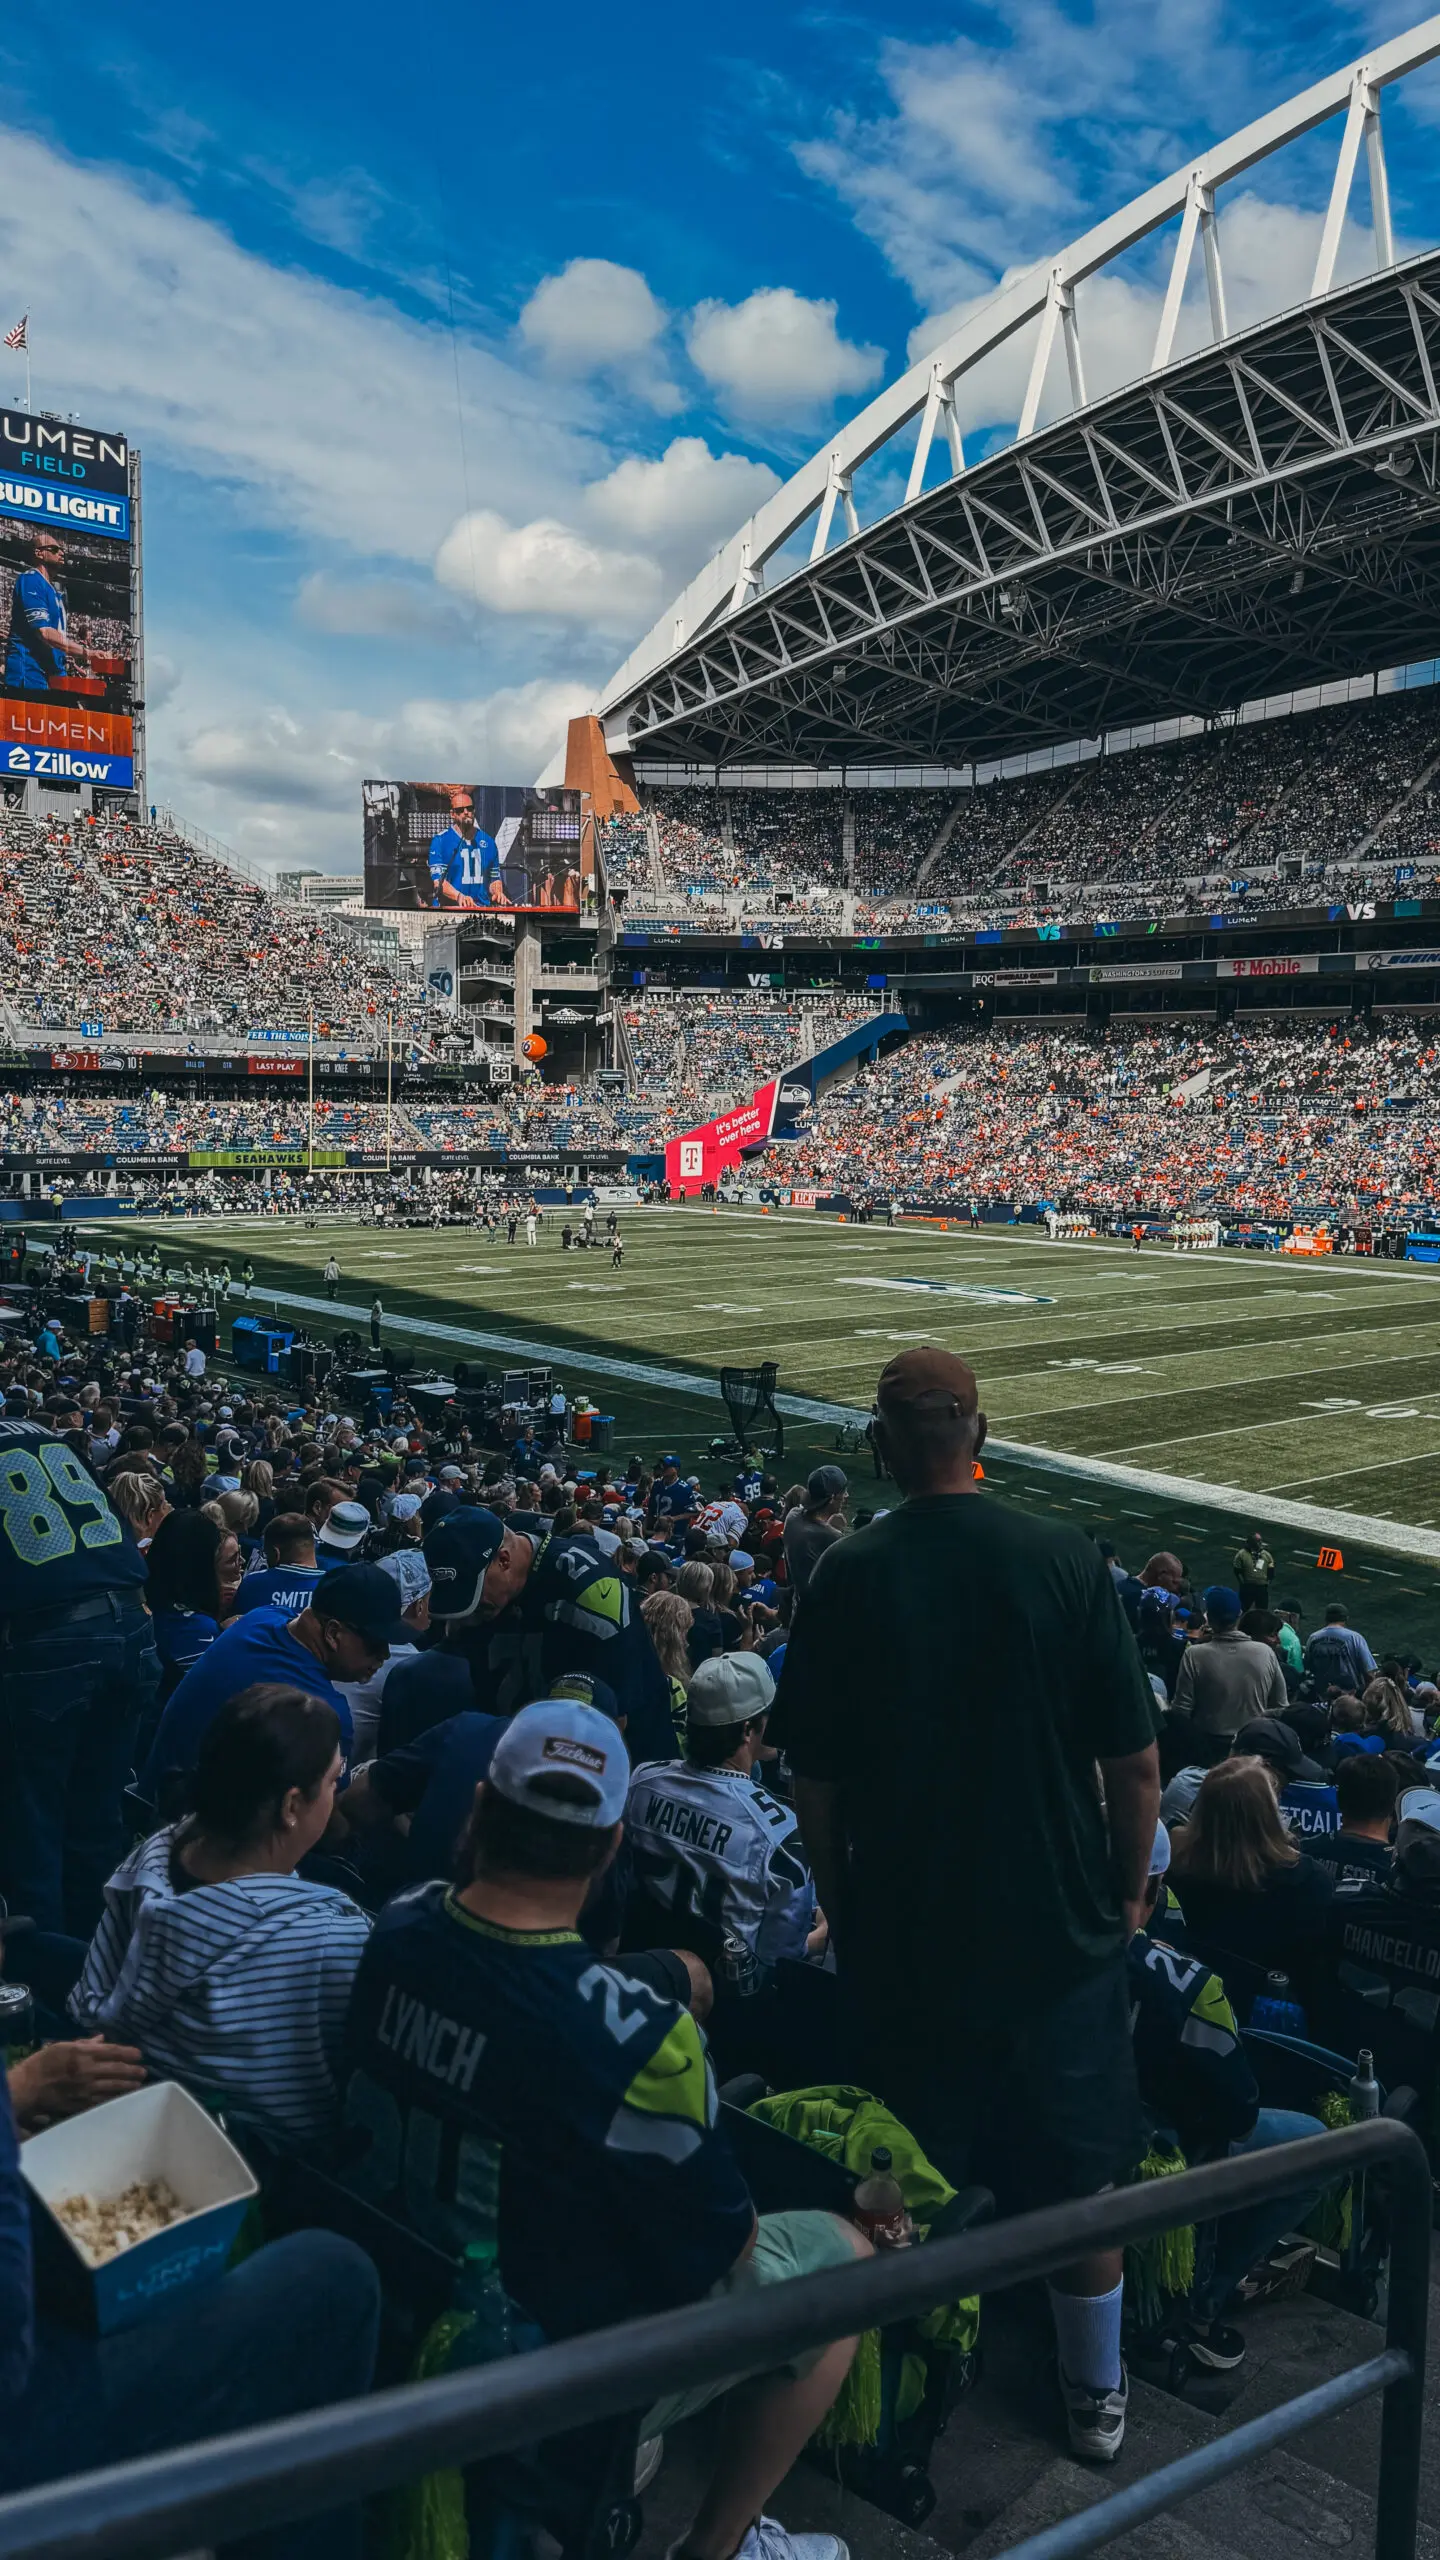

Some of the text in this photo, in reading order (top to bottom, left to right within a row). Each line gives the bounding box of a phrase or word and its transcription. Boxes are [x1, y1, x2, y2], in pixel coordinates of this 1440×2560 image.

[0, 416, 126, 467] UMEN
[21, 451, 86, 478] FIELD
[46, 491, 121, 526] LIGHT
[11, 715, 105, 742] LUMEN
[34, 751, 109, 780] Zillow
[460, 847, 484, 885] 11
[1400, 869, 1411, 879] 12
[692, 886, 701, 895] 12
[860, 888, 871, 897] 12
[876, 888, 885, 896] 12
[920, 906, 928, 915] 12
[937, 906, 945, 914] 12
[1346, 902, 1376, 920] VS
[1036, 925, 1061, 941] VS
[758, 934, 784, 950] VS
[1249, 957, 1301, 976] Mobile
[747, 973, 771, 987] VS
[975, 974, 994, 986] EQC
[85, 1024, 100, 1037] 12
[247, 1031, 269, 1040] FEEL
[270, 1032, 288, 1041] THE
[82, 1055, 137, 1069] 7 10
[256, 1062, 296, 1071] LAST PLAY
[334, 1063, 349, 1074] KNEE
[405, 1061, 419, 1072] VS
[493, 1066, 507, 1079] 25
[715, 1107, 760, 1136] It's better
[718, 1120, 761, 1147] over here
[35, 1157, 72, 1165] SUITE LEVEL
[116, 1155, 179, 1164] COLUMBIA BANK
[235, 1154, 303, 1164] SEAHAWKS
[398, 1154, 416, 1162] BANK
[744, 1482, 762, 1501] 99
[0, 1443, 123, 1567] 89
[655, 1494, 673, 1518] 12
[1321, 1550, 1337, 1568] 10
[644, 1795, 733, 1857] WAGNER
[1343, 1922, 1440, 1980] CHANCELLO
[377, 1984, 488, 2092] LYNCH
